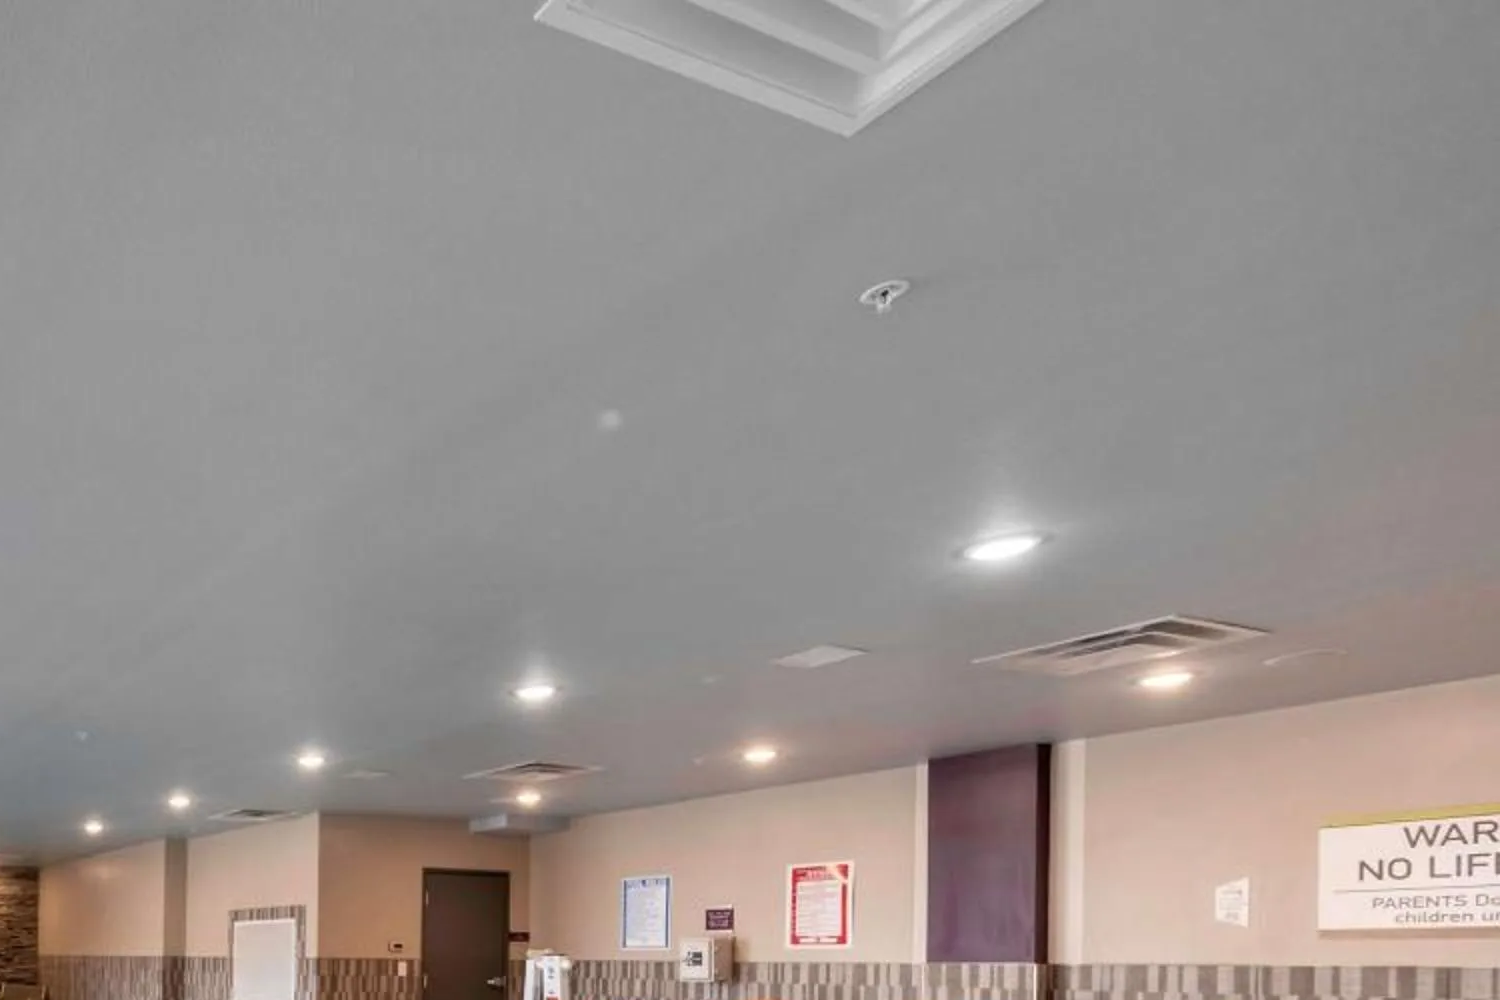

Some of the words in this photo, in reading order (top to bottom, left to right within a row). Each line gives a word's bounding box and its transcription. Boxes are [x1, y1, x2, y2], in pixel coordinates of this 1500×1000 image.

[1403, 820, 1500, 848] WAR
[1358, 857, 1412, 881] NO
[1429, 851, 1500, 878] LIF
[1372, 895, 1468, 909] PARENTS
[1395, 911, 1474, 924] children
